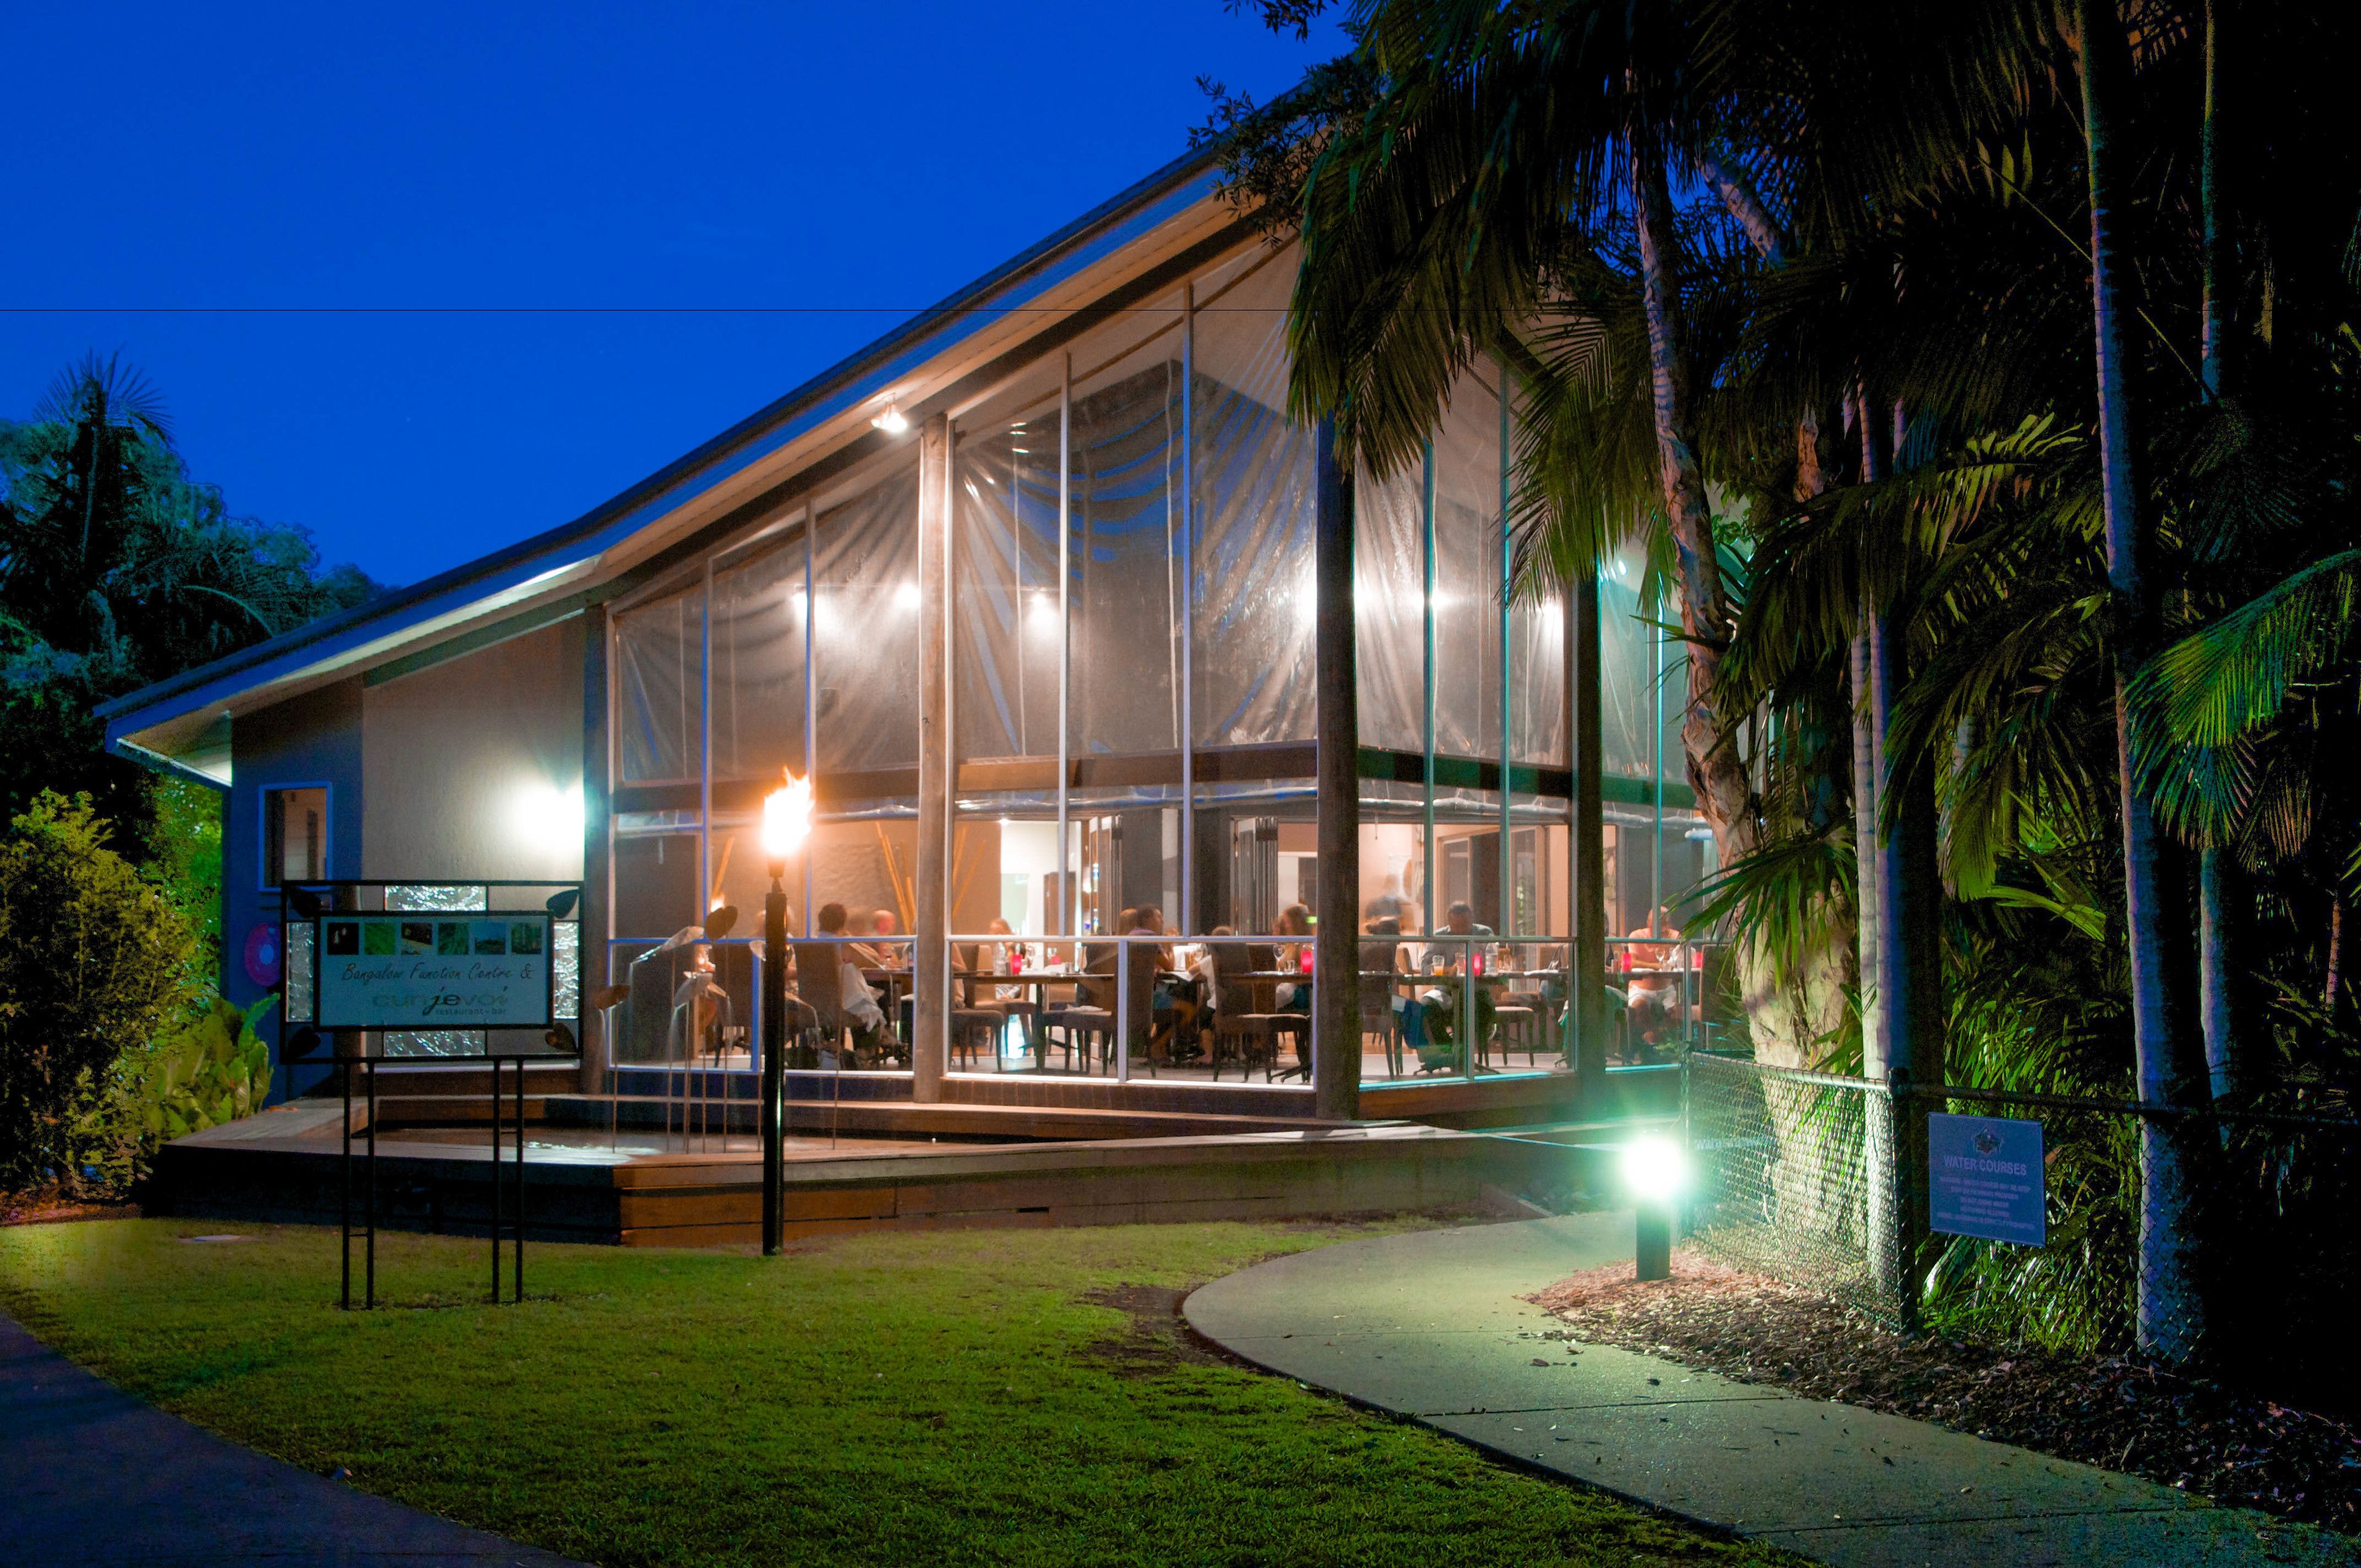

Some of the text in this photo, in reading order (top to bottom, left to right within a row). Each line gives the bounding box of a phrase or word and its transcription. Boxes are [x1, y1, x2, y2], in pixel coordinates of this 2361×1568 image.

[342, 962, 536, 985] Bangalow Function Centre &
[1944, 1155, 2027, 1176] WATER COURSES
